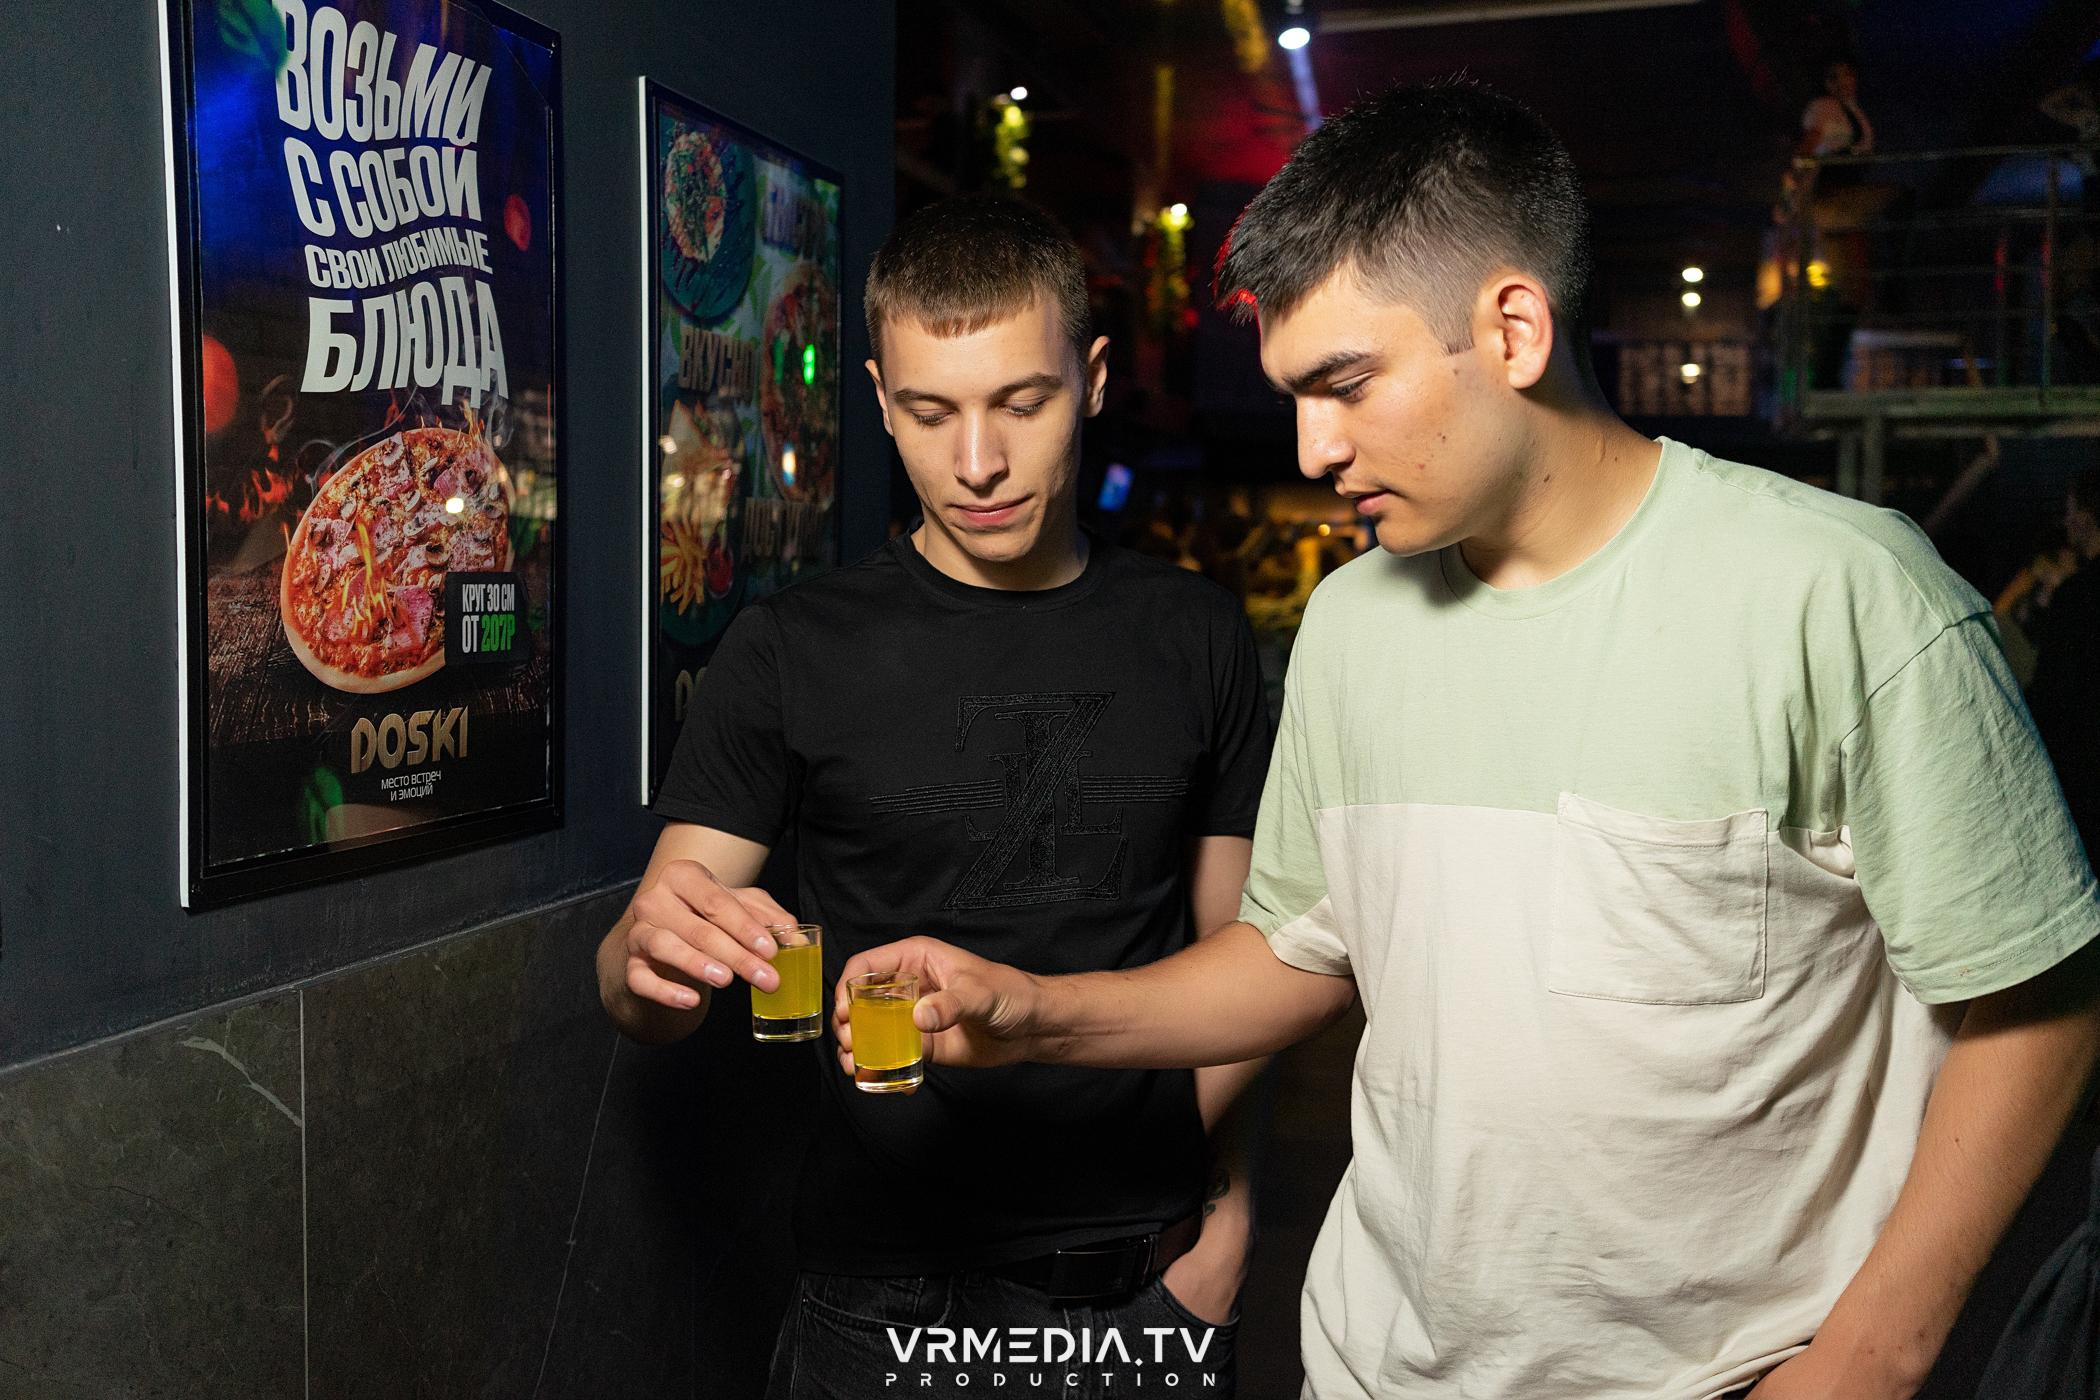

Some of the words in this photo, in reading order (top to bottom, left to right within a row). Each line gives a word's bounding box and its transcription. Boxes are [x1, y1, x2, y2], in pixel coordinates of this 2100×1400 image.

[272, 0, 493, 144] ВОЗЬМИ
[284, 137, 336, 237] С
[329, 134, 482, 239] СОБОЙ
[305, 243, 386, 290] СВОИ
[385, 226, 493, 284] ЛЮБИМЫЕ
[300, 276, 509, 409] БЛЮДА
[462, 584, 487, 612] КРУГ
[486, 583, 500, 612] 30
[501, 583, 515, 611] СМ
[461, 614, 480, 654] ОТ
[350, 705, 470, 775] DOSKI
